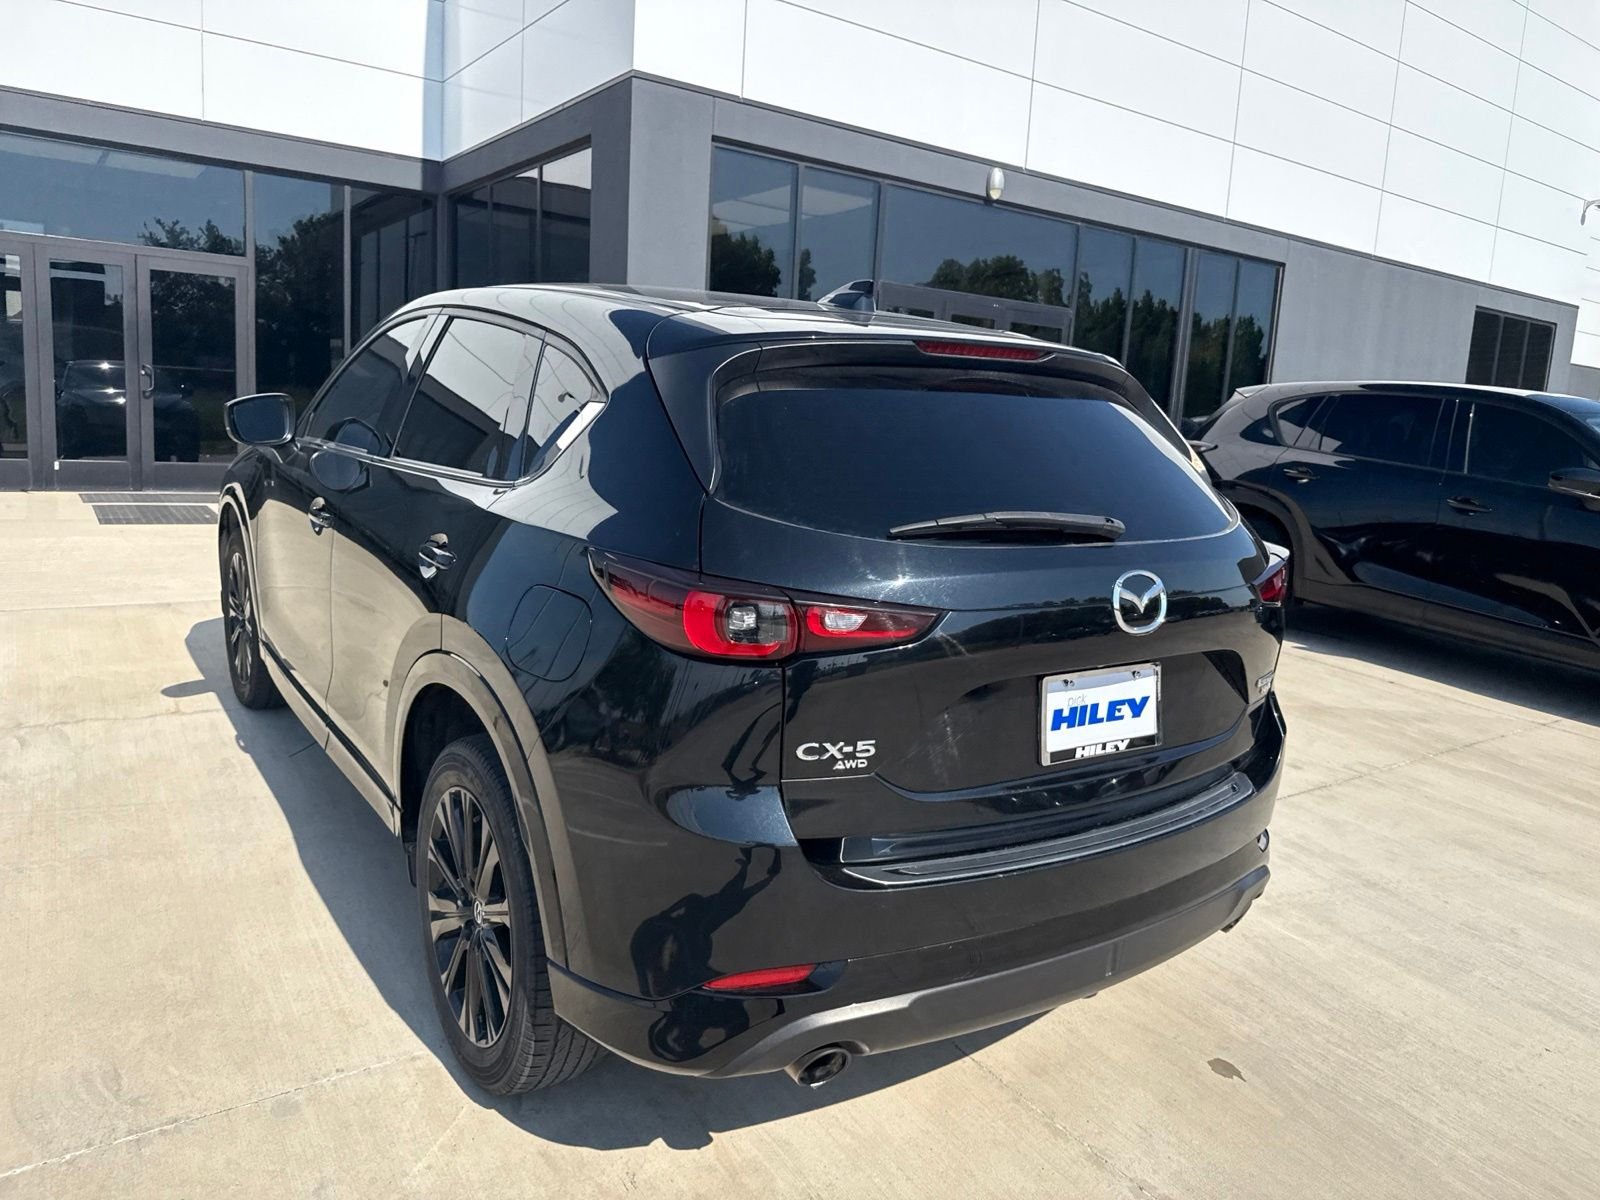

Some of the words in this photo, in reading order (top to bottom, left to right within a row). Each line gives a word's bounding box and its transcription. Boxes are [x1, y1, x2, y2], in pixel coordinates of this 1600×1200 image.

[1051, 696, 1150, 731] HILEY
[796, 740, 876, 760] CX-5
[1075, 739, 1130, 759] HILEY
[833, 759, 868, 770] AWD
